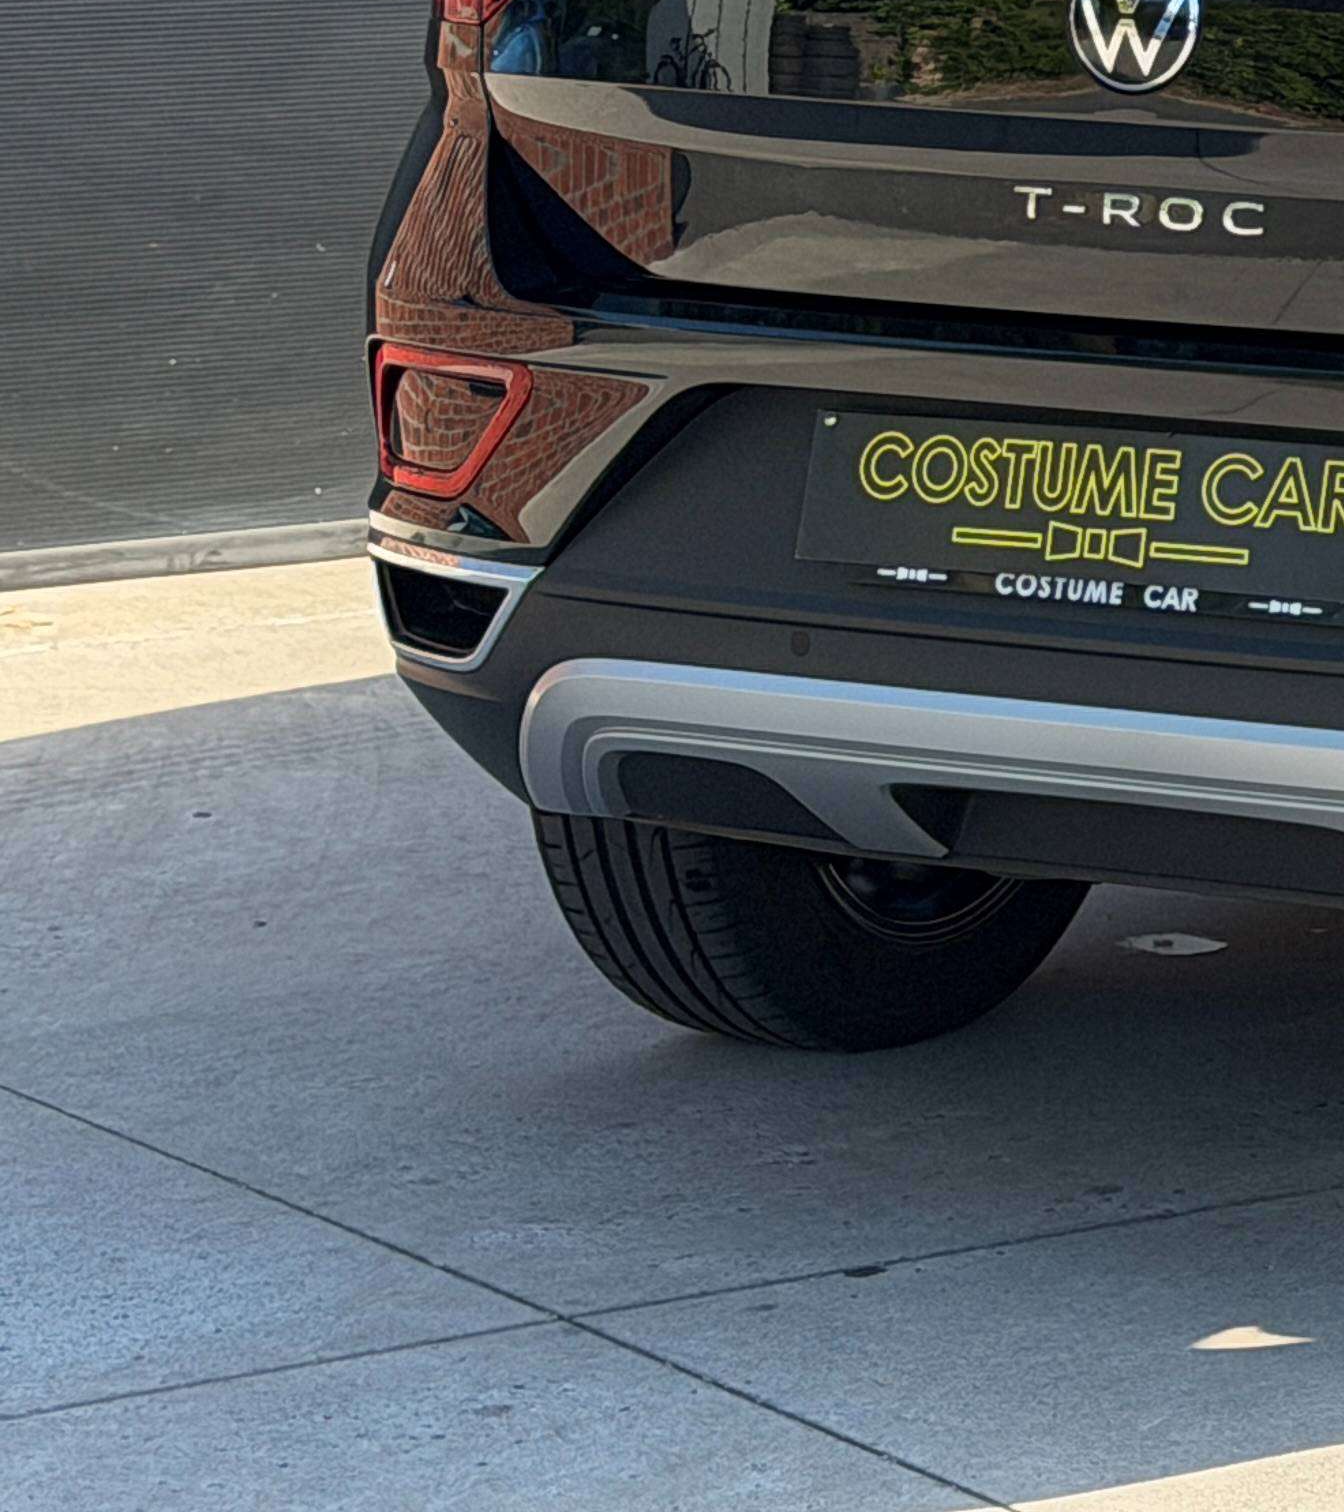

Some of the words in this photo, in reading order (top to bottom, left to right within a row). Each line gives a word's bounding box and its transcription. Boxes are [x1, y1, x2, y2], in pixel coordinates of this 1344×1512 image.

[1013, 186, 1264, 235] T-ROC
[860, 431, 1182, 520] COSTUME
[996, 572, 1123, 605] COSTUME
[1144, 585, 1198, 612] CAR
